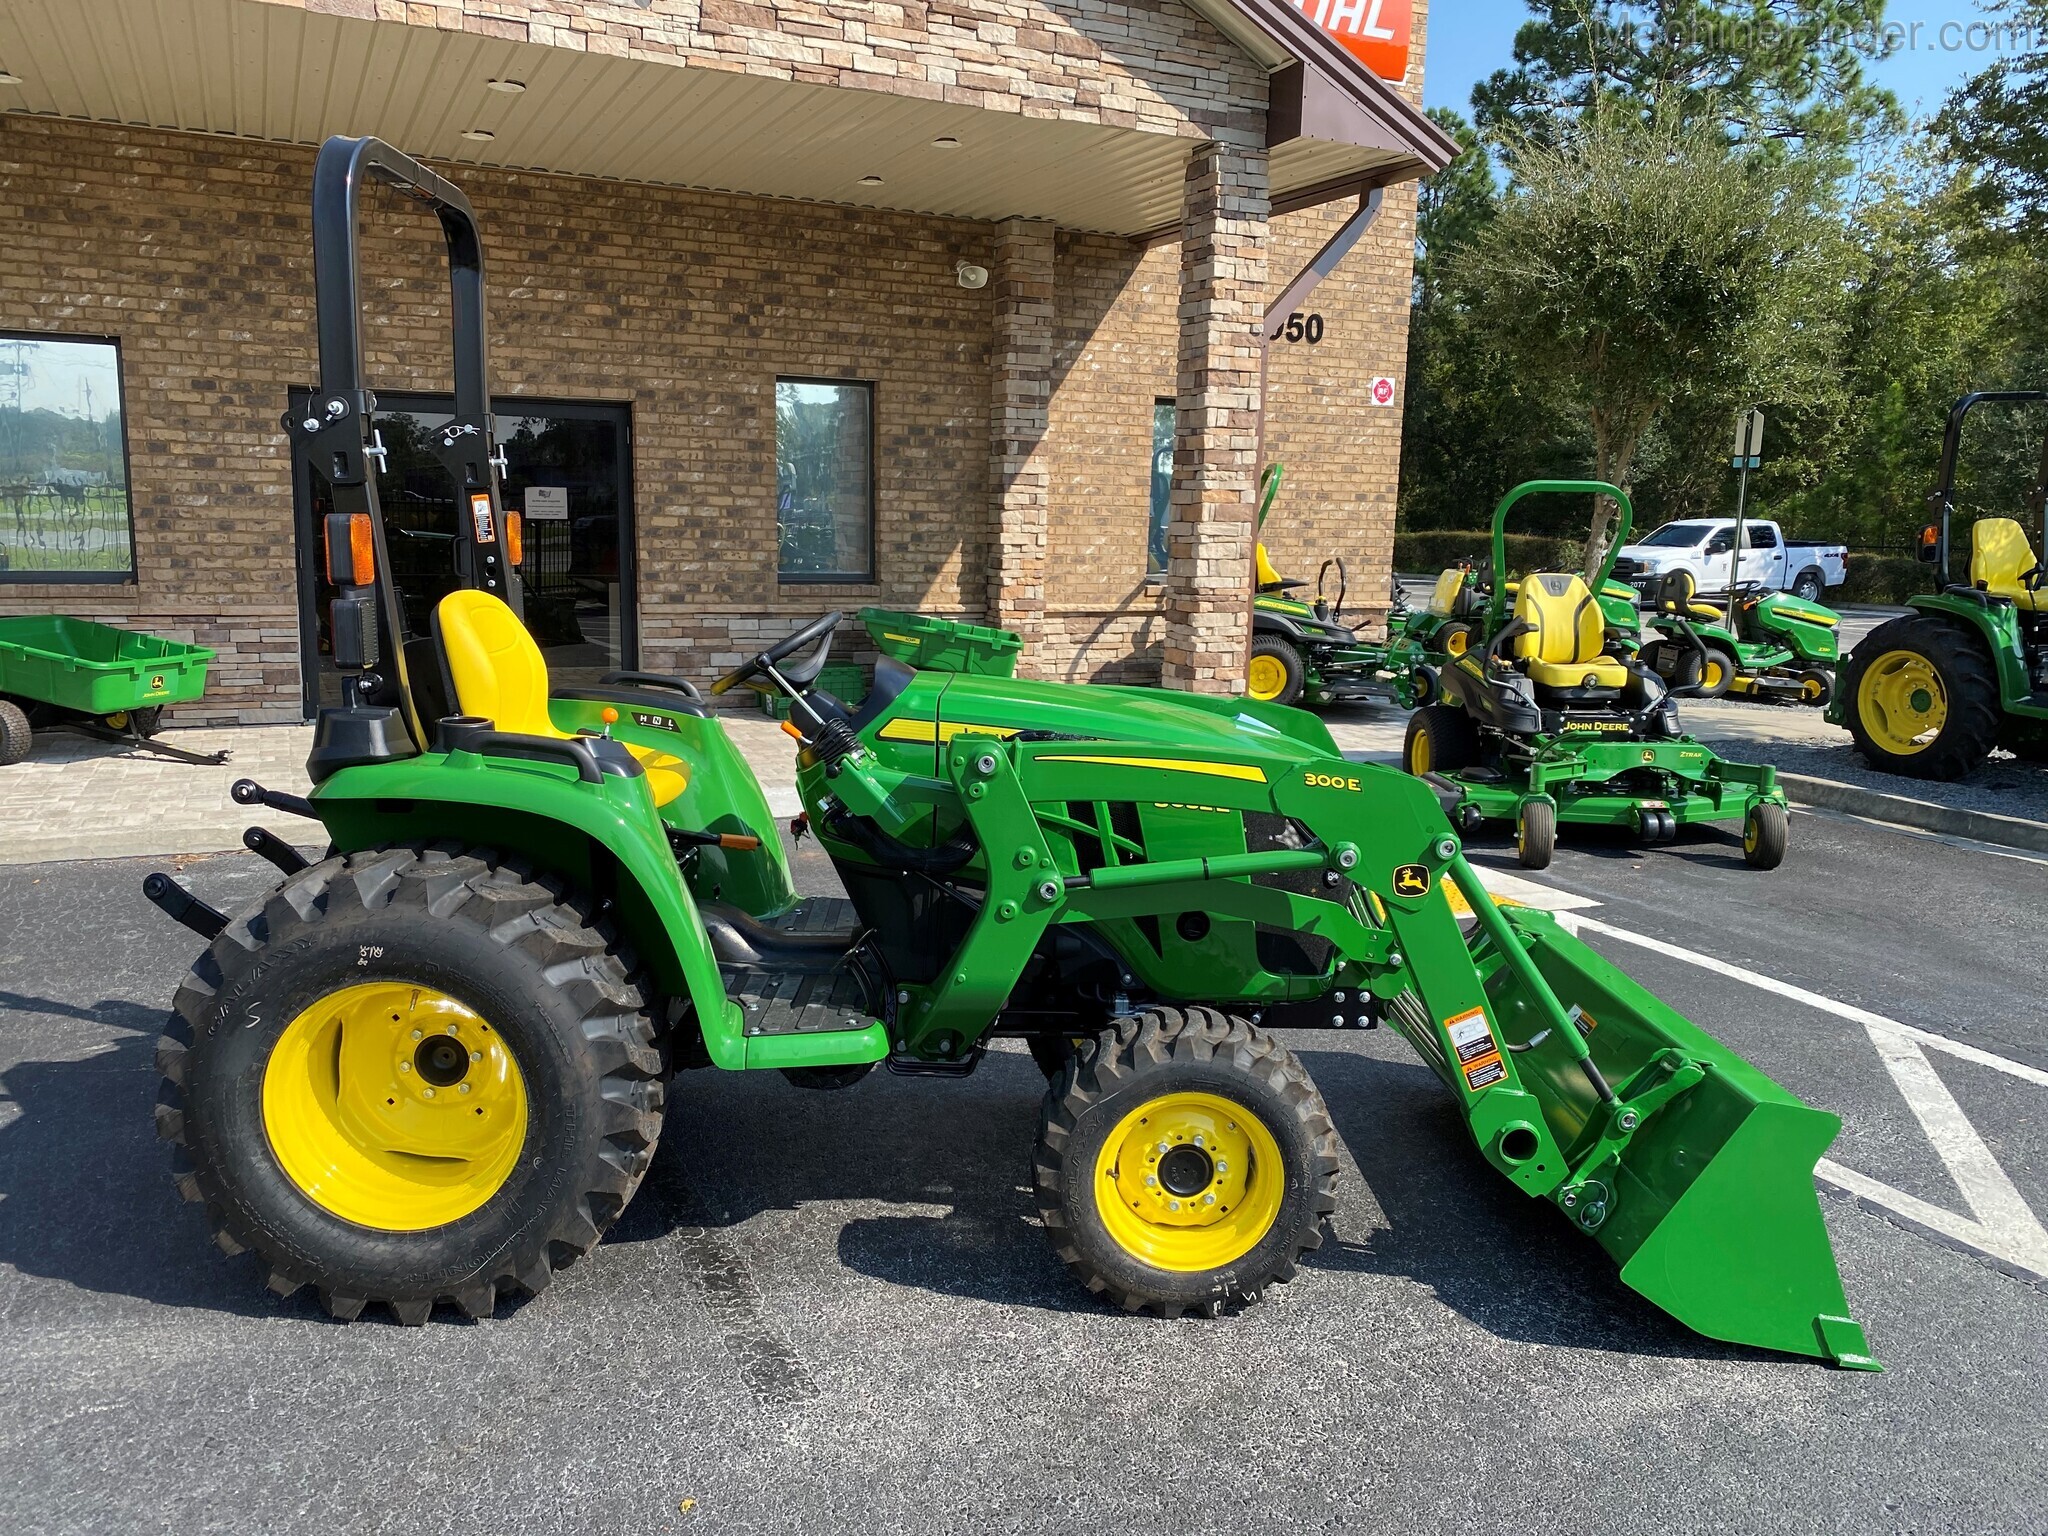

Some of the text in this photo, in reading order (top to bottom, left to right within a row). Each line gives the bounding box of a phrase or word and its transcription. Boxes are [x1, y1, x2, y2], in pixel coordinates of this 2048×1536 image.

[1294, 0, 1395, 40] IHL
[640, 714, 647, 722] H
[668, 719, 674, 727] L
[1563, 721, 1630, 731] JOHN DEERE
